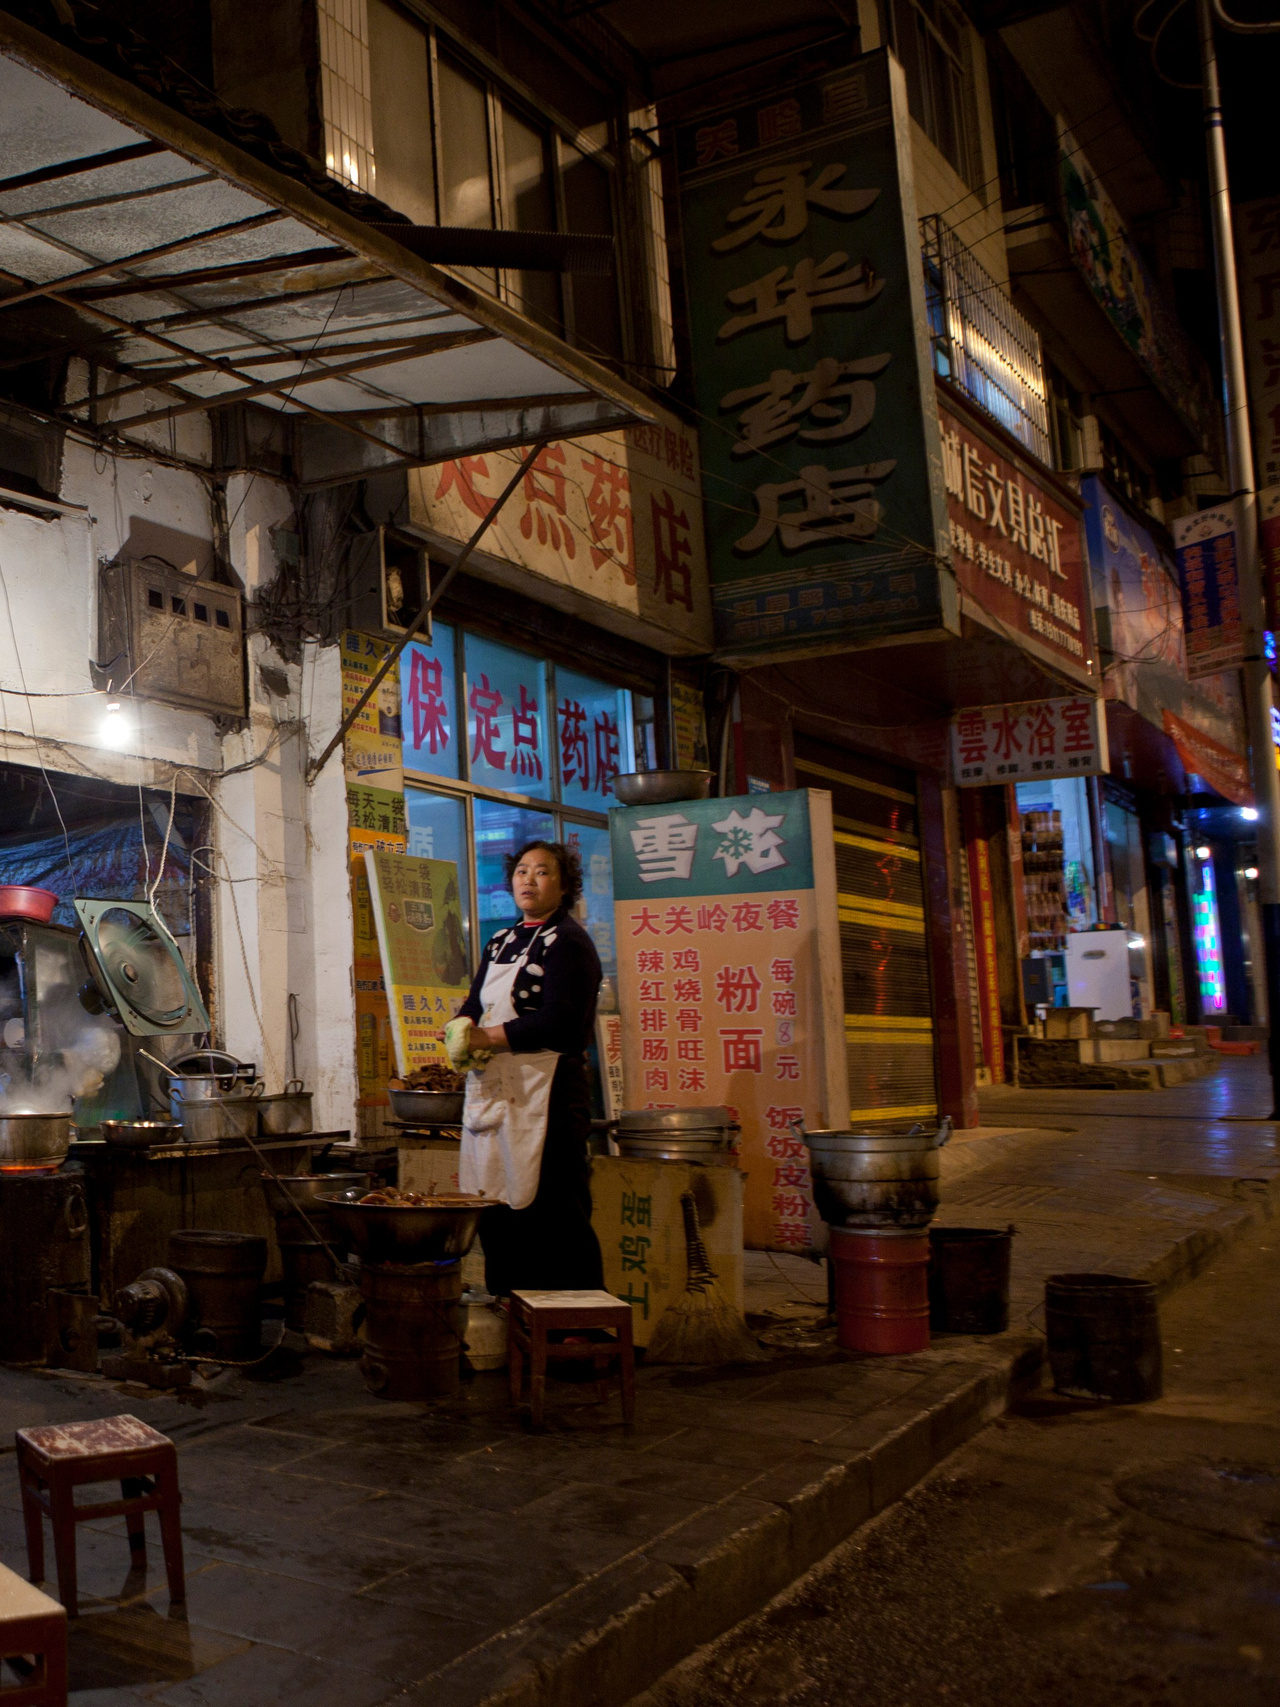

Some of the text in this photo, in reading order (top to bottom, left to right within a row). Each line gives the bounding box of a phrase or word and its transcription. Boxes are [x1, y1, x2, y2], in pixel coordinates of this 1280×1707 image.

[712, 160, 897, 556] 永华药店
[400, 648, 621, 800] 保定点药店
[958, 699, 1095, 765] 雲水浴室
[347, 788, 404, 817] 每天一袋
[629, 806, 790, 884] 雪花
[630, 899, 800, 937] 大关岭夜餐
[637, 948, 701, 975] 辣鸡
[639, 978, 703, 1004] 红烧
[639, 1008, 703, 1034] 排骨
[717, 965, 763, 1075] 粉面
[771, 958, 800, 1082] 每碗8元
[642, 1038, 706, 1064] 肠旺
[645, 1068, 708, 1093] 肉沫
[617, 1190, 653, 1322] 土鸡蛋
